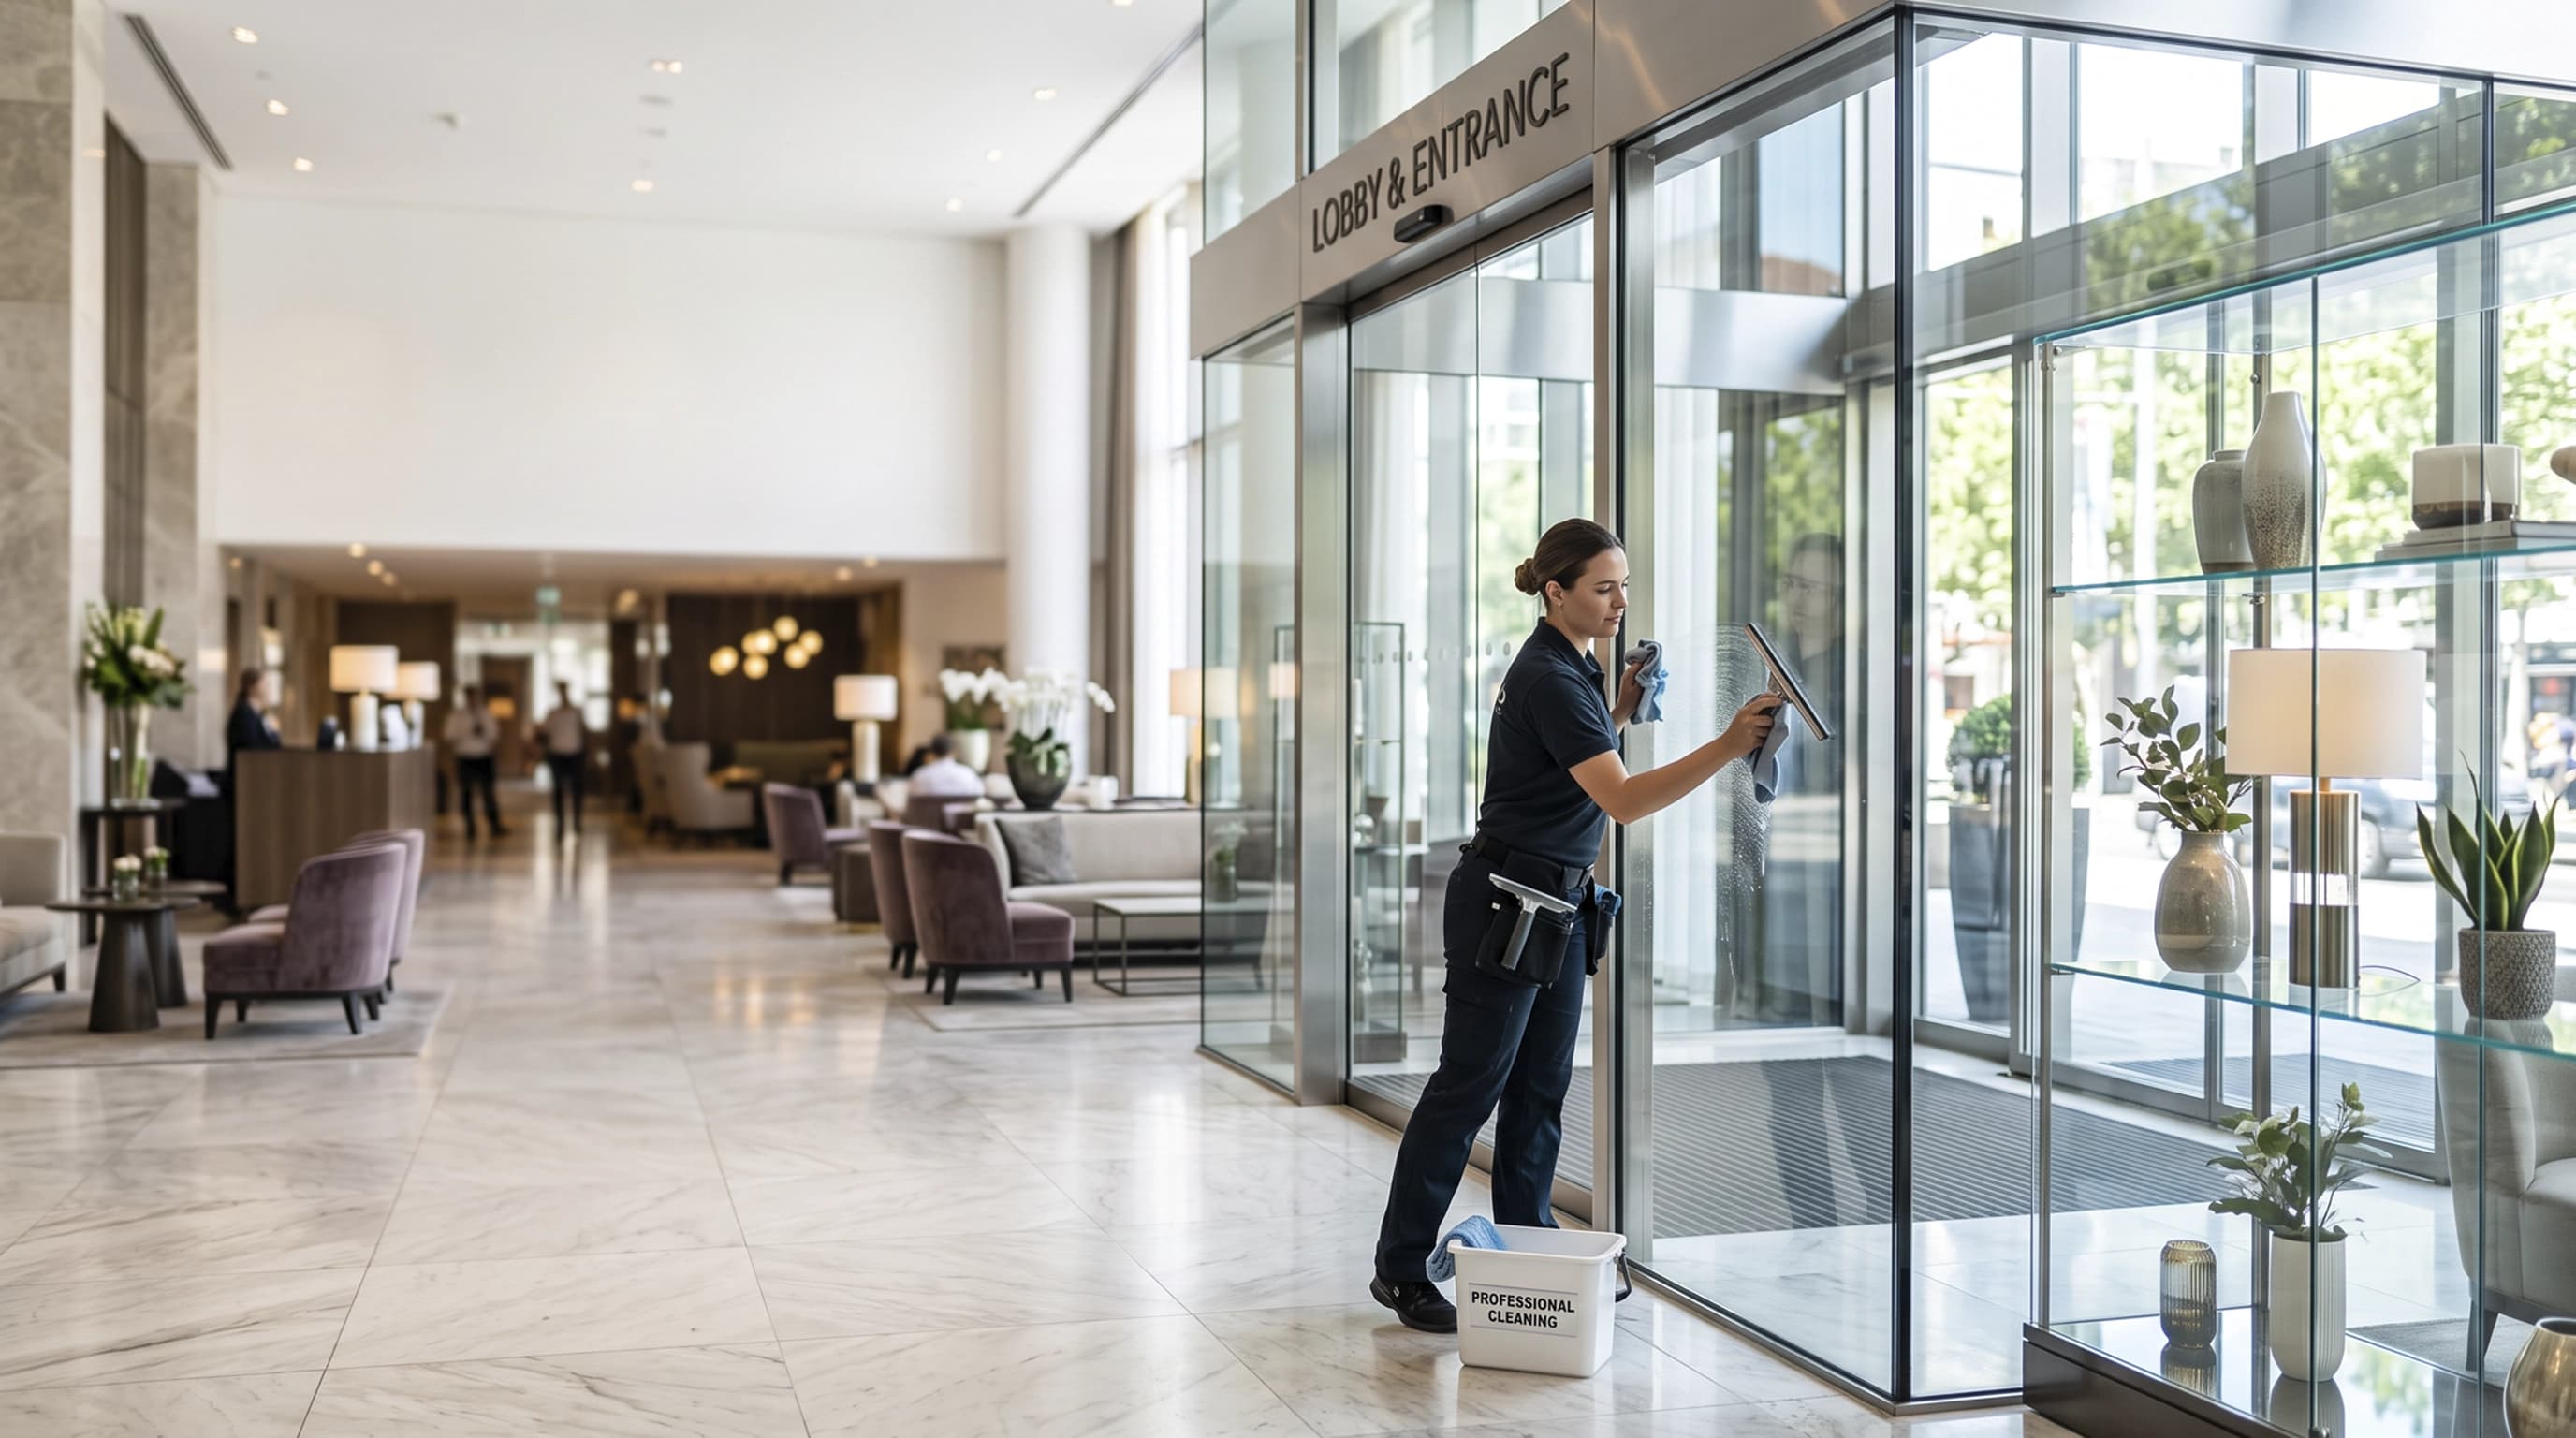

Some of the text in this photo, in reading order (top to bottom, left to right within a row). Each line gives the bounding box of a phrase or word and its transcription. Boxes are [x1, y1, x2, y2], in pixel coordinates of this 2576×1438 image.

[1312, 52, 1570, 253] LOBBY & ENTRANCE
[1471, 1291, 1575, 1313] PROFESSIONAL
[1488, 1310, 1558, 1328] CLEANING
